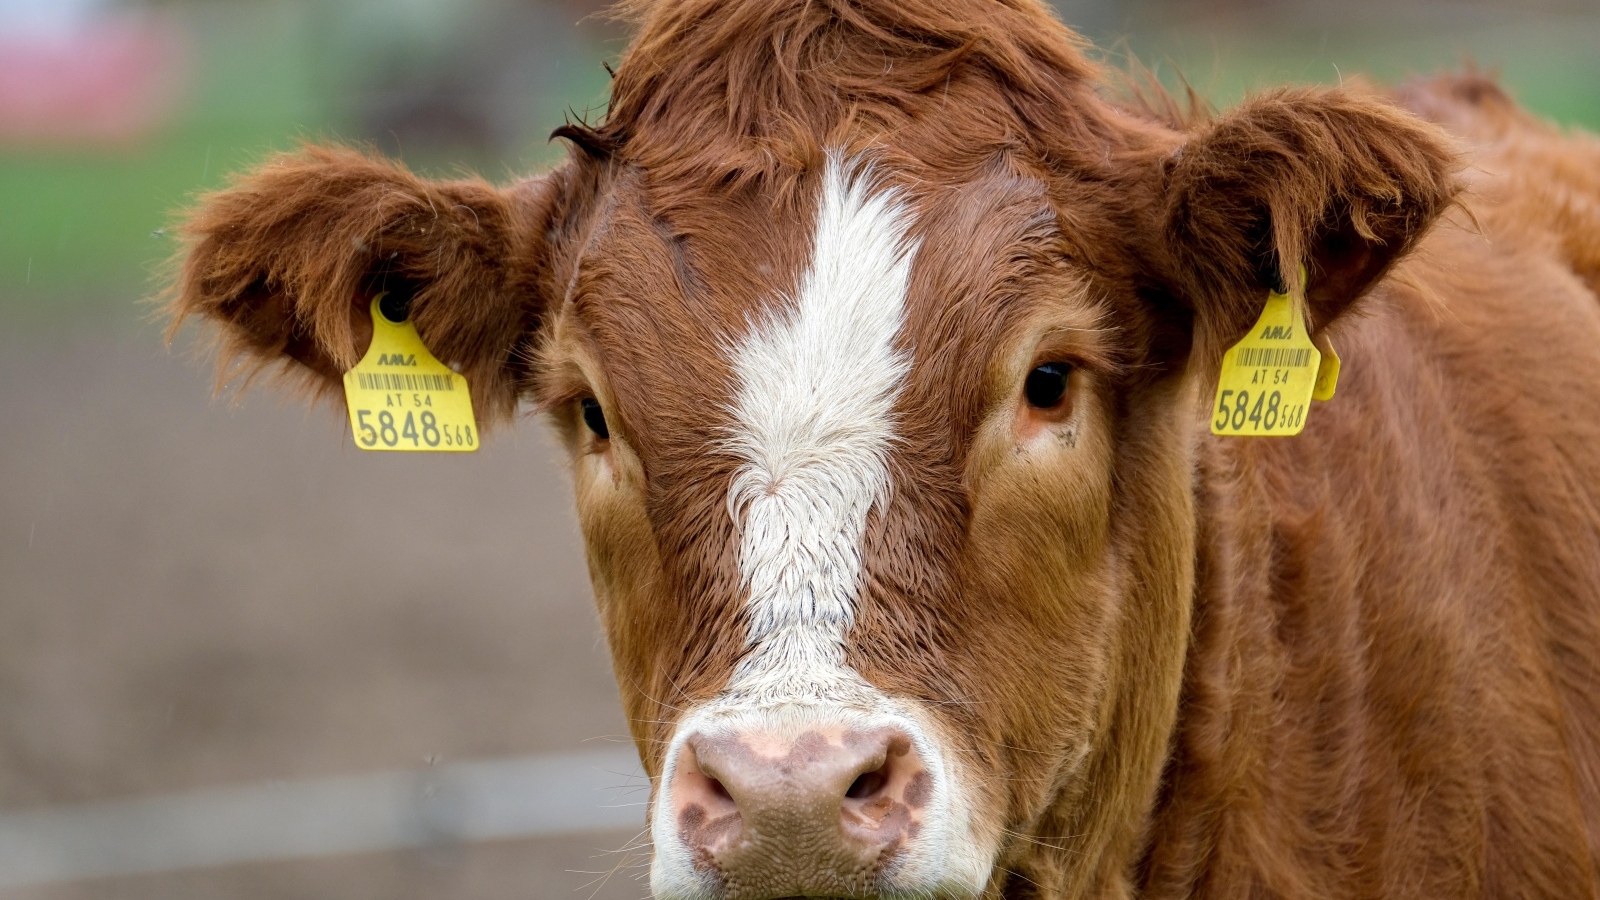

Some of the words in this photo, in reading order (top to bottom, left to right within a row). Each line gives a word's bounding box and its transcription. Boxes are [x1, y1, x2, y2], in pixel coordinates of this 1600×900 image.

[1251, 369, 1267, 384] AT
[1273, 369, 1289, 384] 54
[386, 394, 403, 407] AT
[413, 394, 432, 407] 54
[1215, 389, 1281, 431] 5848
[1280, 404, 1303, 428] 568
[357, 410, 440, 447] 5848
[443, 424, 473, 446] 568
